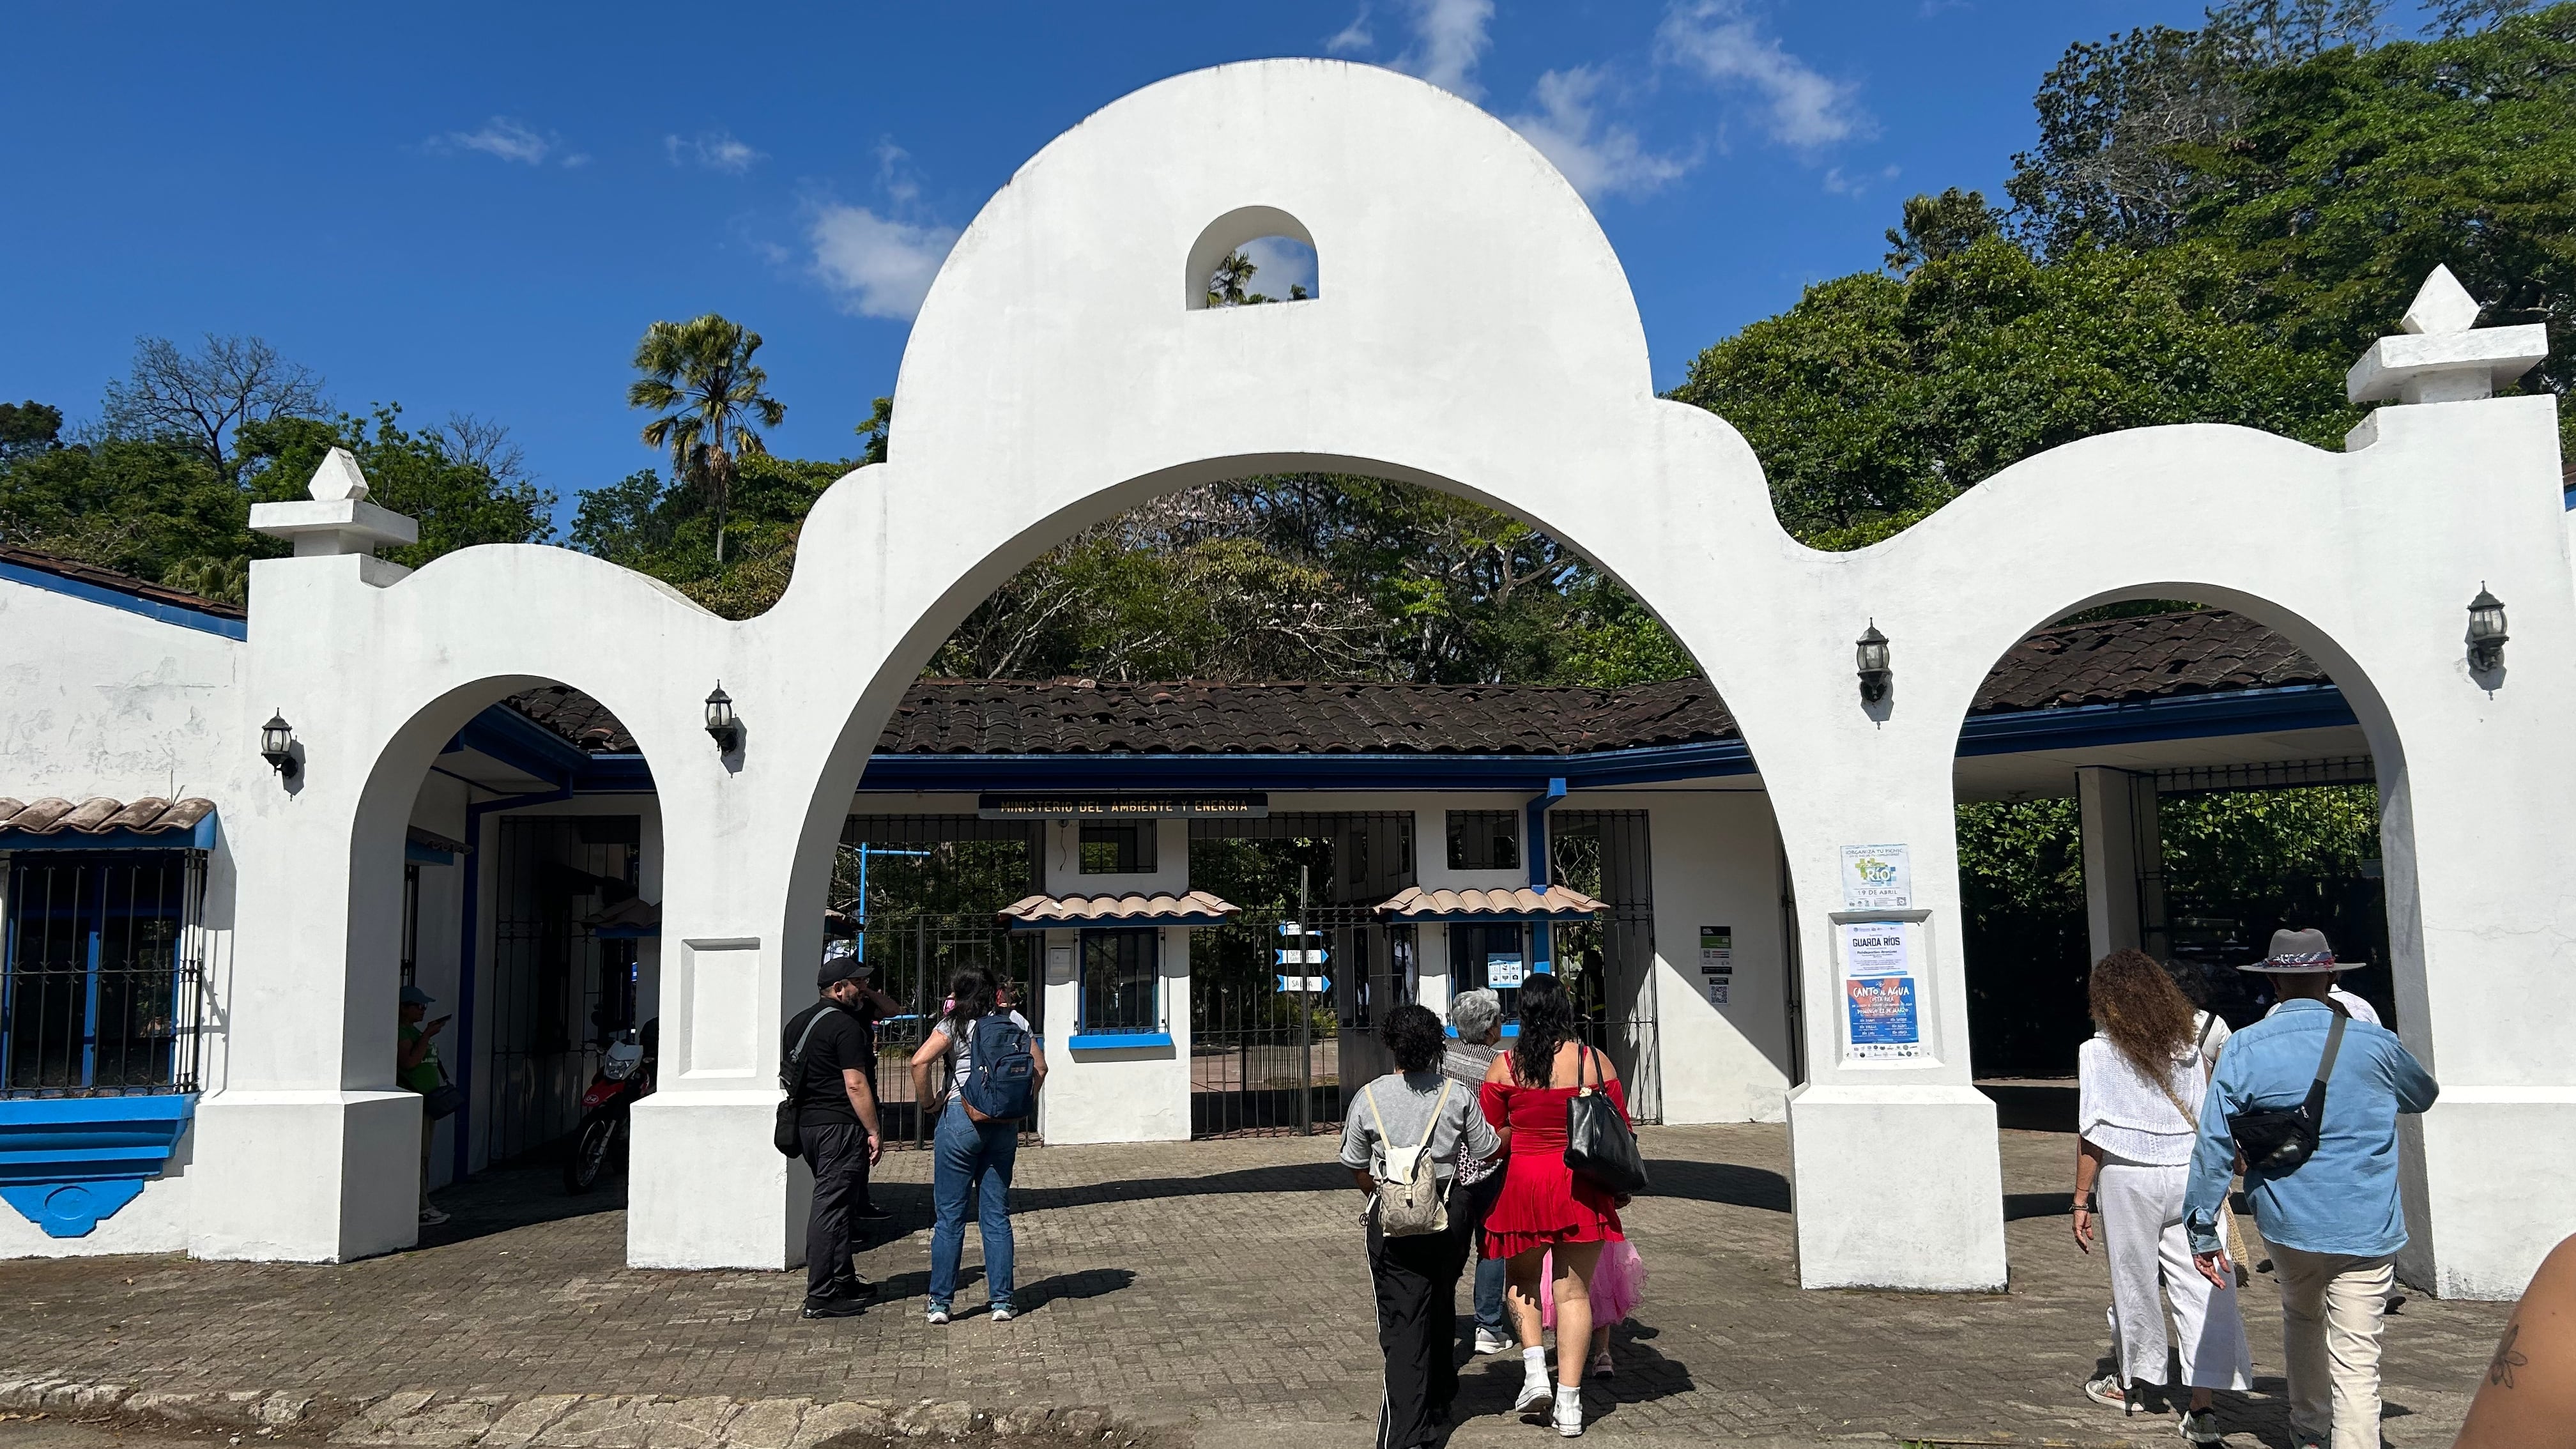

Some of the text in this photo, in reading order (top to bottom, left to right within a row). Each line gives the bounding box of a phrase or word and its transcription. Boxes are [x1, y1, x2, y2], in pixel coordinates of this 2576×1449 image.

[1000, 801, 1073, 813] MINISTERIO
[1079, 801, 1103, 813] DEL
[1111, 800, 1173, 812] AMBIENTE
[1181, 801, 1188, 811] Y
[1866, 868, 1890, 881] RÍO
[1852, 935, 1900, 947] GUARDA RÍOS
[1853, 987, 1878, 997] CANTO
[1888, 986, 1910, 996] AGUA
